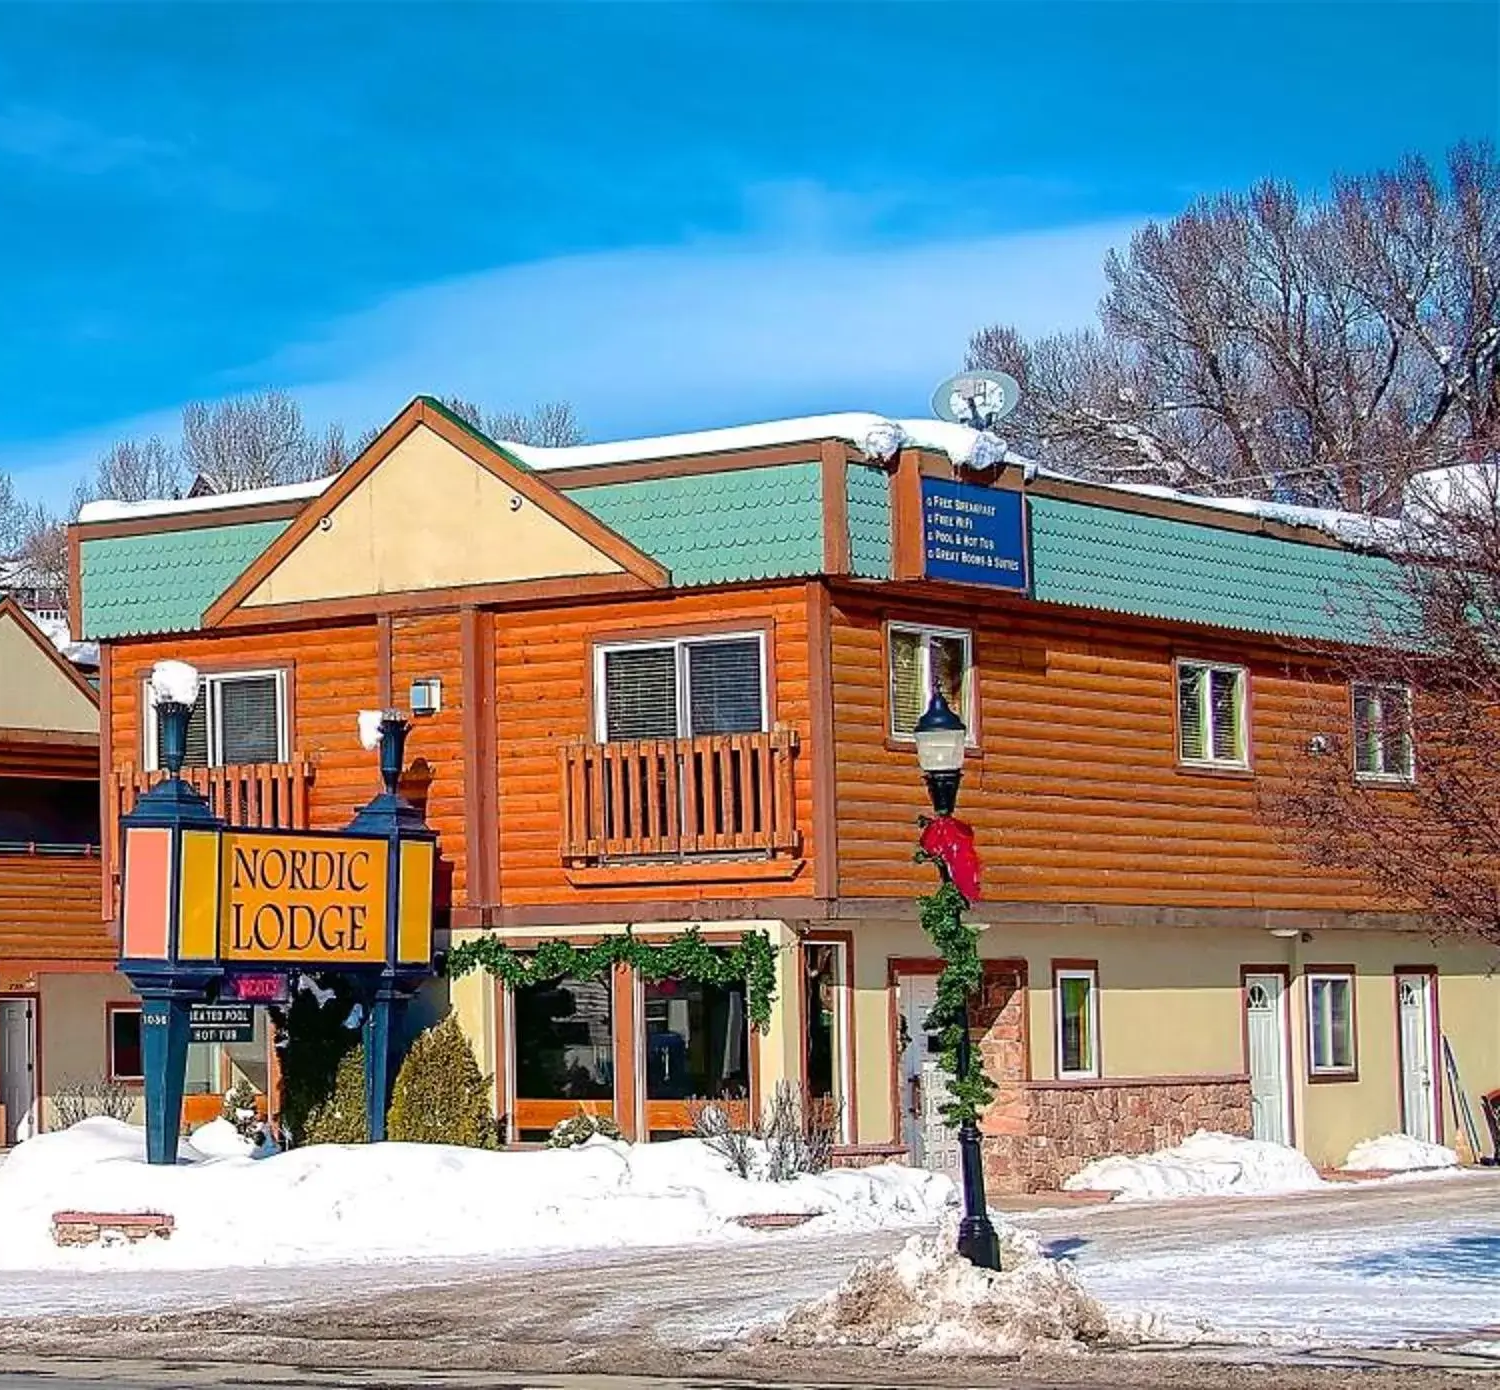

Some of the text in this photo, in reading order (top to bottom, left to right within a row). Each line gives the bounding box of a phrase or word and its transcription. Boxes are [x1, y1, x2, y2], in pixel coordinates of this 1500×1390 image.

[232, 847, 370, 892] NORDIC
[232, 903, 368, 952] LODGE
[224, 1010, 249, 1022] POOL
[219, 1030, 238, 1041] TUB
